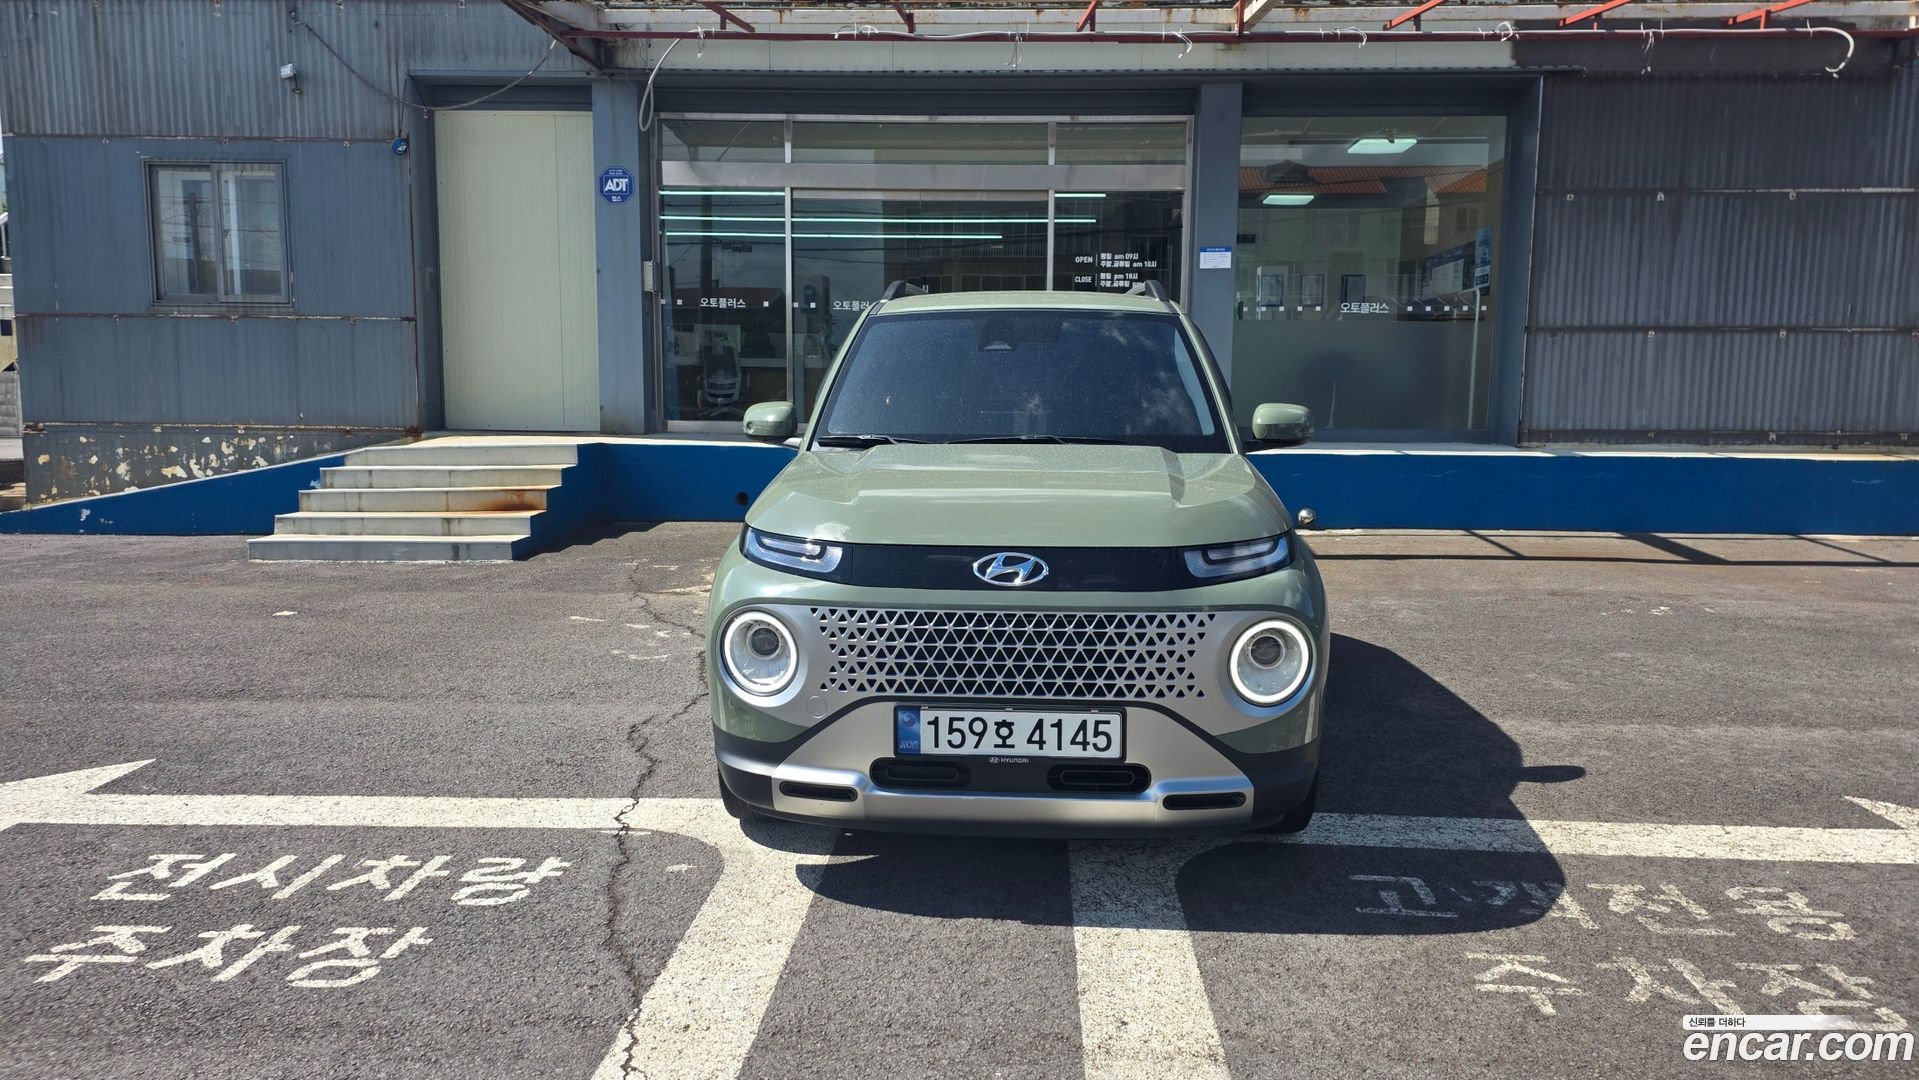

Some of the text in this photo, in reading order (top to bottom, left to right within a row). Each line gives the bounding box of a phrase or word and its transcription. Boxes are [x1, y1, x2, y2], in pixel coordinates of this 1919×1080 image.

[604, 178, 628, 192] ADT
[700, 298, 746, 308] 오토플러스
[1340, 302, 1389, 314] 오토플러스
[926, 716, 1112, 752] 159호 4145
[90, 852, 571, 907] 전시차량
[23, 922, 434, 989] 주차장
[1466, 951, 1909, 1032] 주차장
